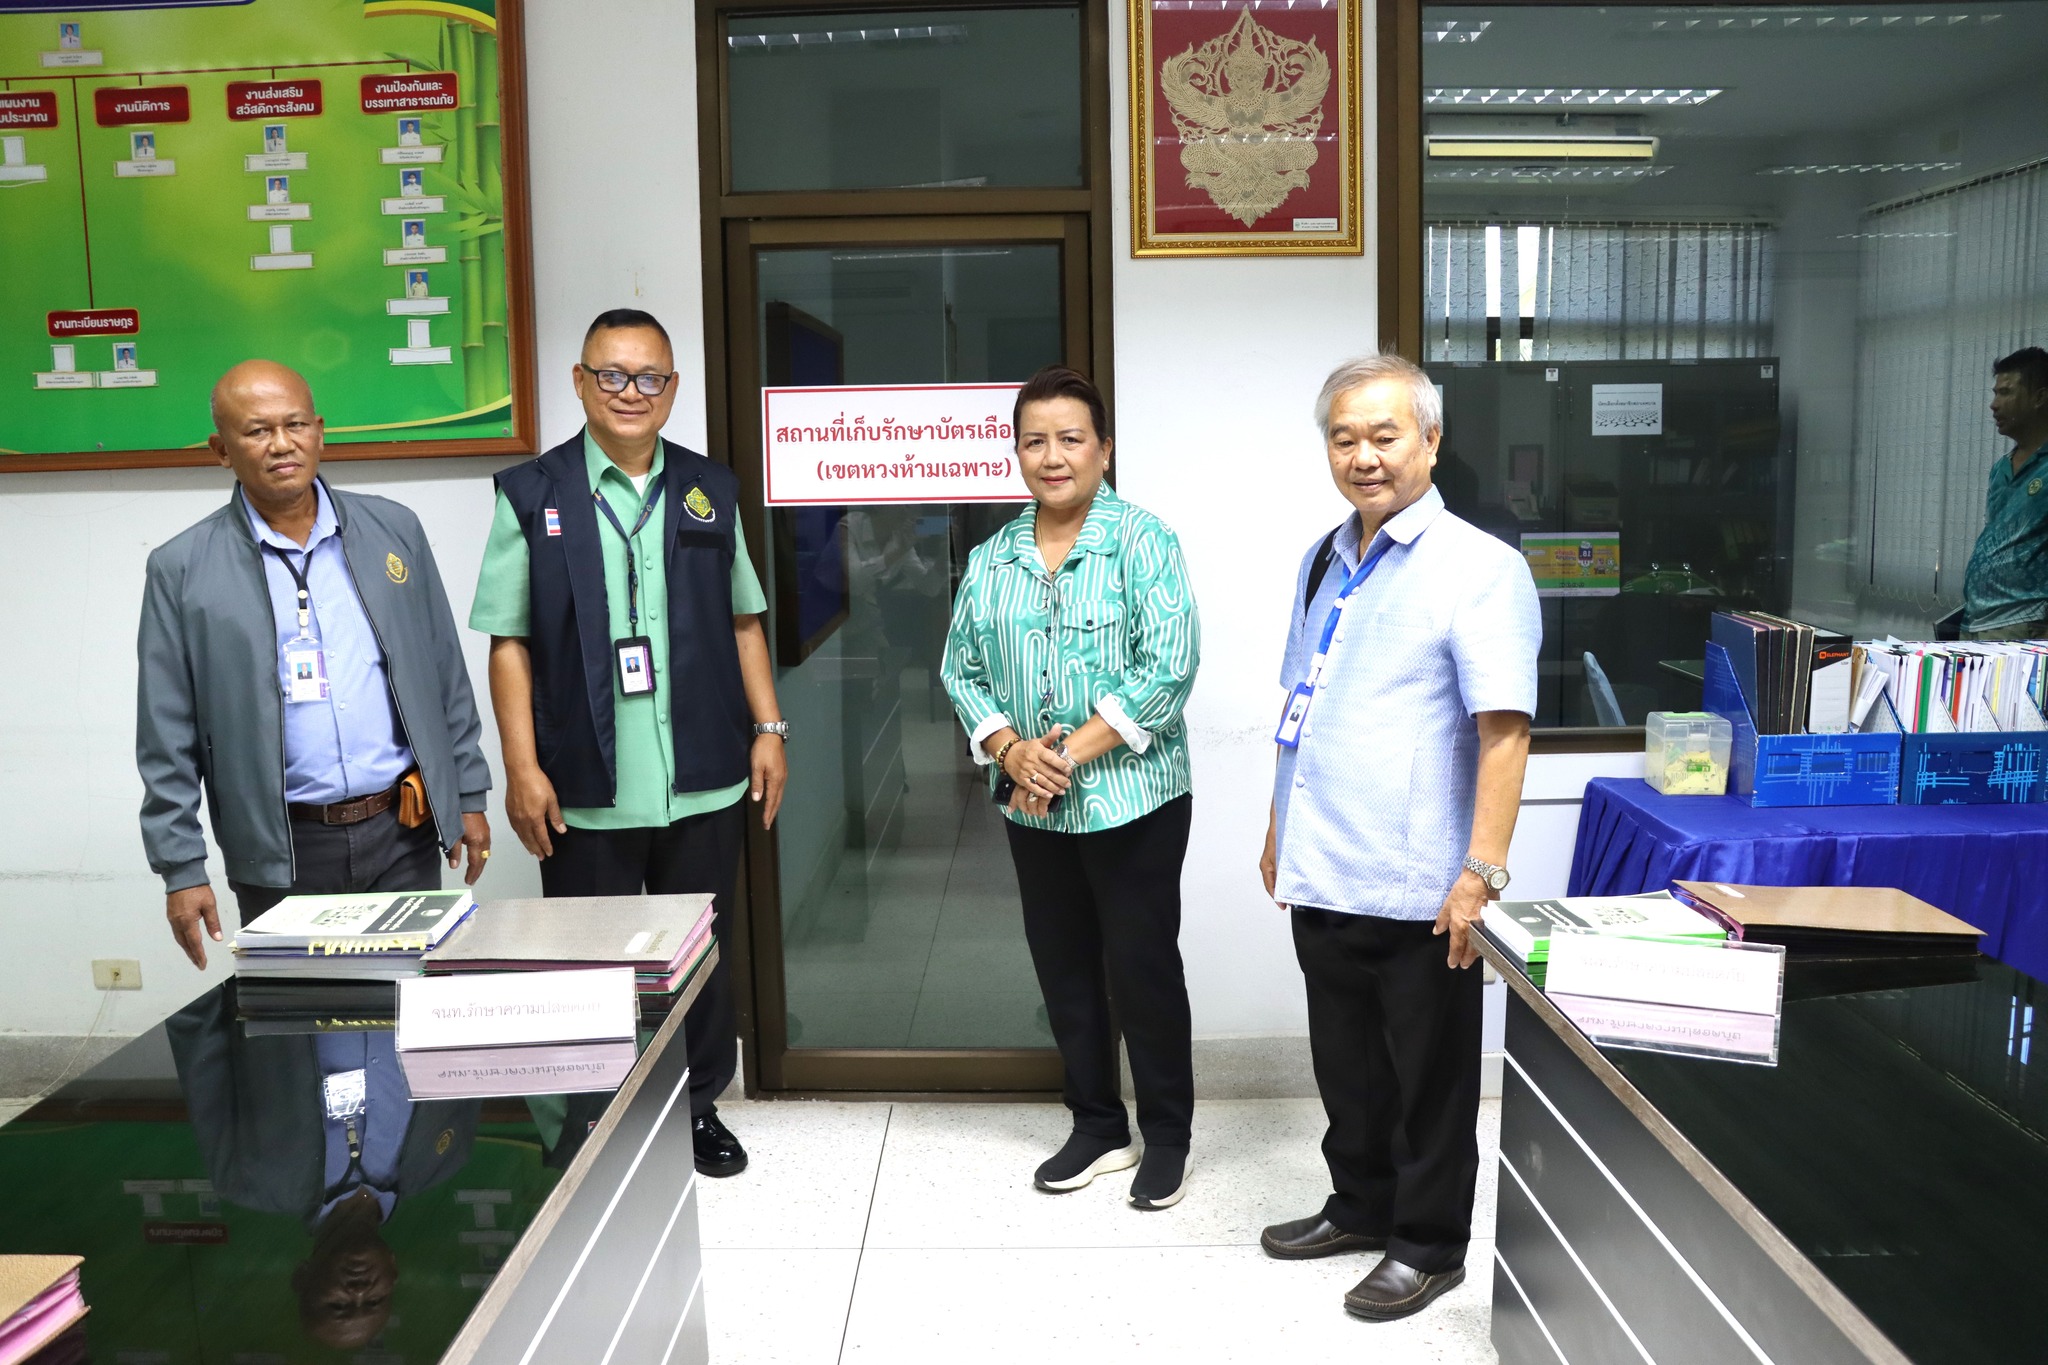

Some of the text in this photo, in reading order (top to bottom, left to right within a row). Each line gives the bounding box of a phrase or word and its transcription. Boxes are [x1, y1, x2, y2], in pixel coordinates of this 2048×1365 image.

[245, 86, 304, 101] งานส่งเสริม
[374, 79, 443, 95] งานป้องกันและ
[114, 100, 171, 113] งานนิติการ
[235, 100, 315, 116] สวัสดิการสังคม
[364, 93, 454, 109] บรรเทาสาธารณภัย
[53, 315, 134, 329] งานทะเบียนราษฎร
[776, 411, 1016, 444] สถานที่เก็บรักษาบัตรเลือ
[816, 454, 1012, 481] (เขตหวงห้ามเฉพาะ)
[432, 1001, 600, 1019] จนท.รักษาความปลอด
